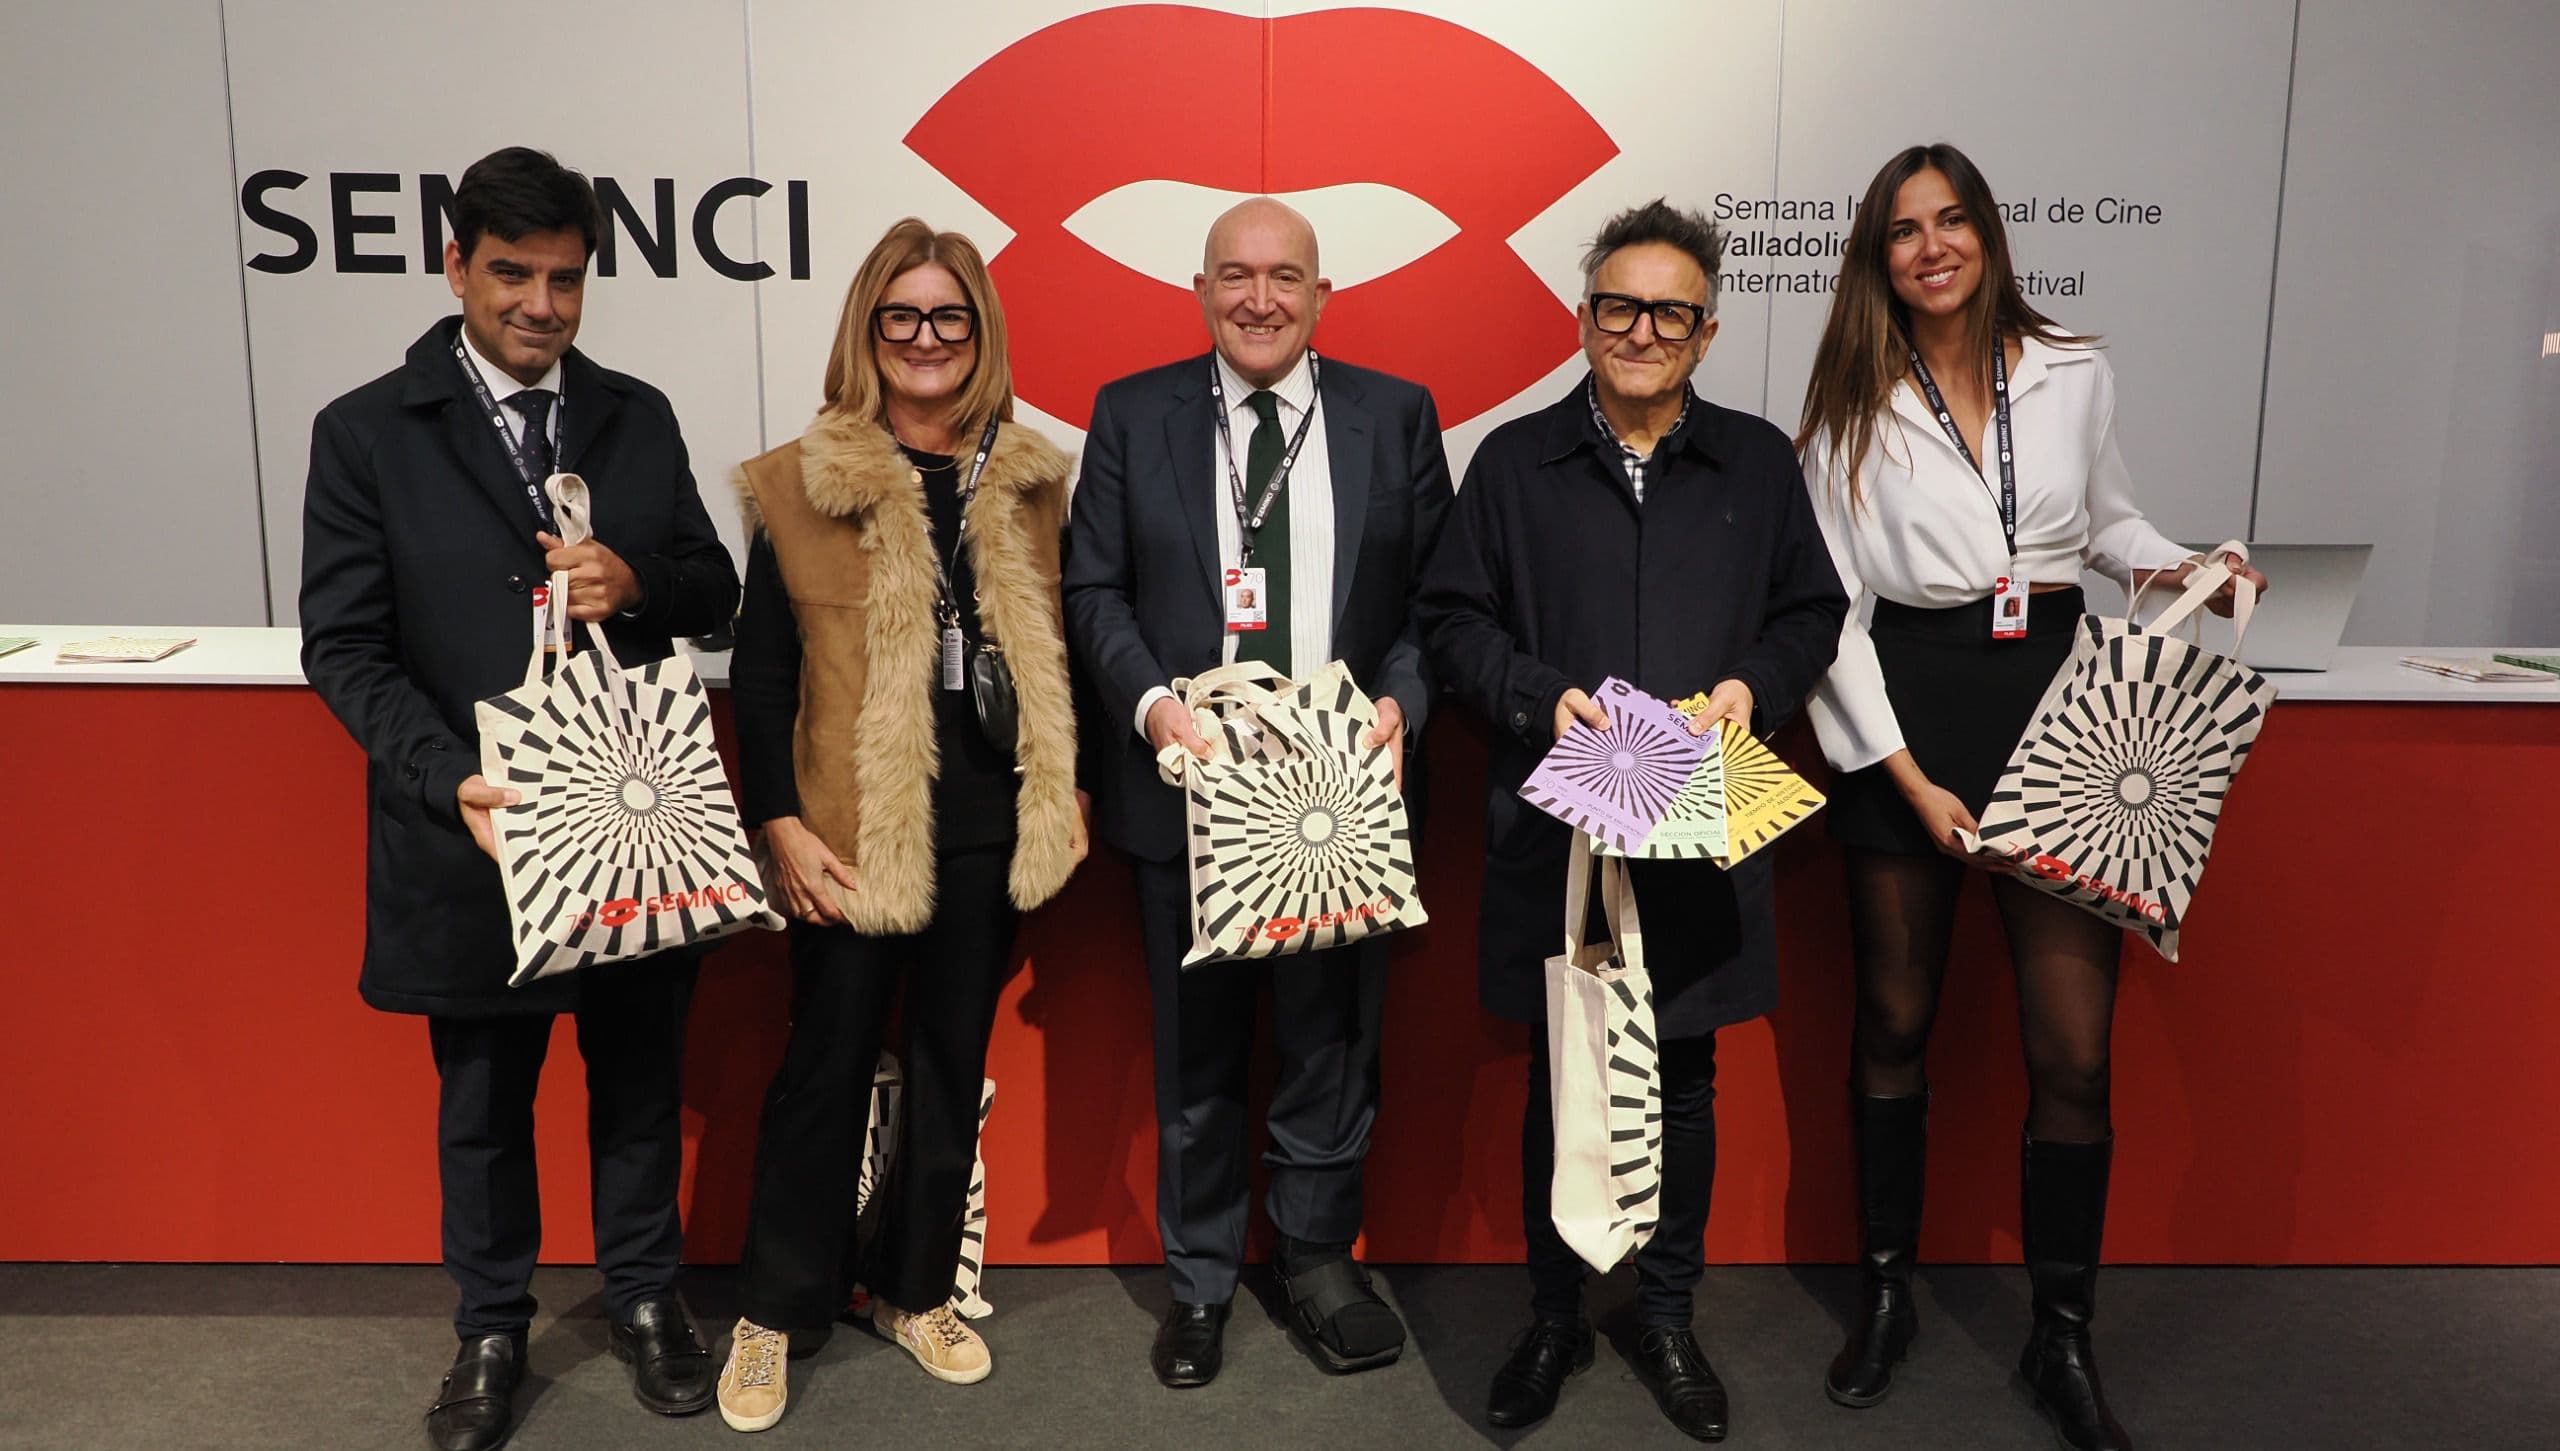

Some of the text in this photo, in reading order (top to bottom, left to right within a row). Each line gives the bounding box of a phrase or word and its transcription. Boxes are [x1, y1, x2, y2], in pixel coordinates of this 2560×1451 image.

[241, 169, 812, 282] SENCI
[1713, 193, 1834, 220] Semana
[2047, 197, 2085, 223] de
[2095, 197, 2162, 224] Cine
[2014, 270, 2085, 297] stival
[2015, 581, 2028, 593] 70
[1667, 713, 1711, 742] SEMCI
[2006, 841, 2169, 923] 70 SEMINCI
[565, 881, 749, 933] 70 SEMINCI
[1234, 895, 1393, 943] 70 SEMINCI
